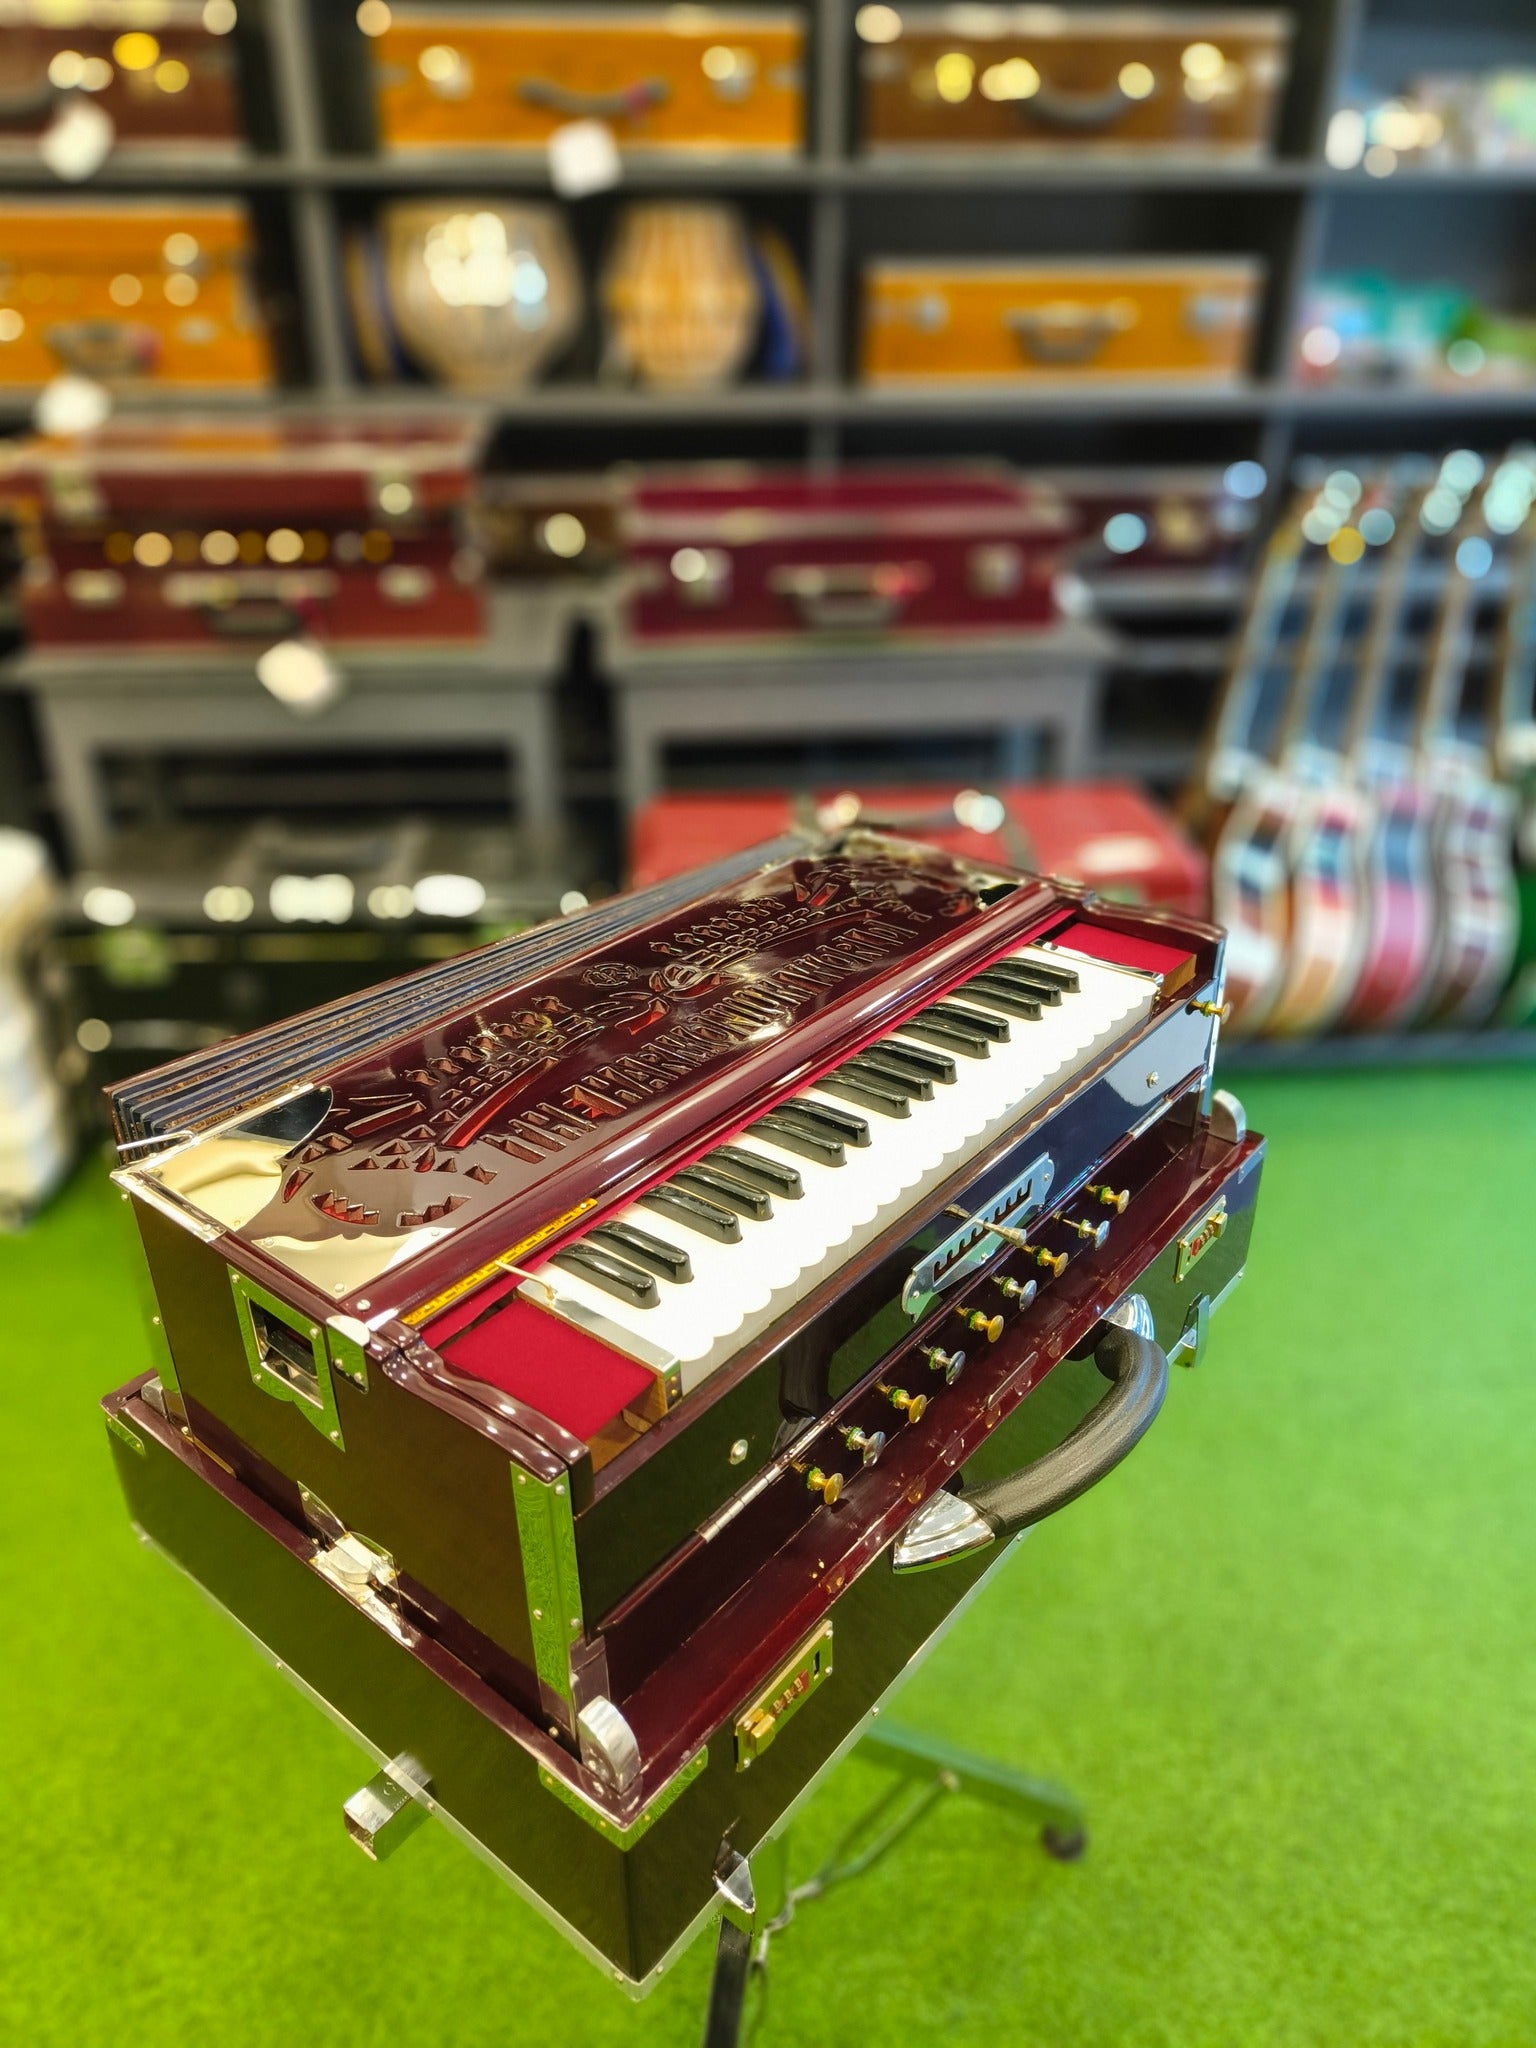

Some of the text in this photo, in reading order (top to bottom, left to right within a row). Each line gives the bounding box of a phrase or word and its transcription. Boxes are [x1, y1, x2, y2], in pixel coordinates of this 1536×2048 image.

[479, 918, 920, 1165] THE HARMONIUM WORLD
